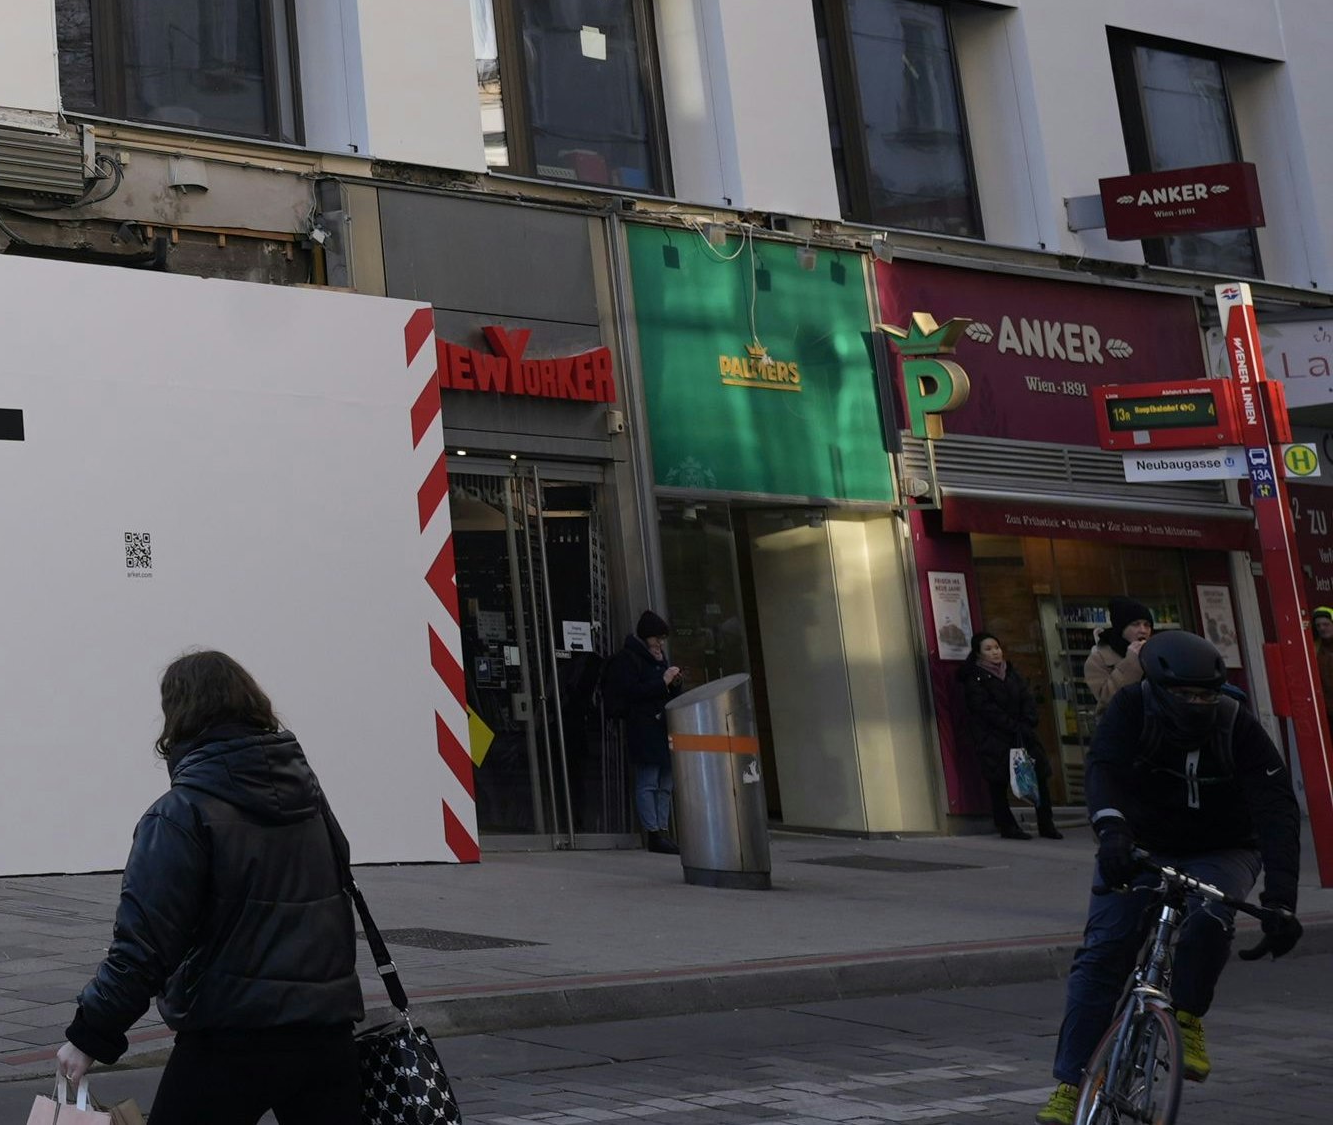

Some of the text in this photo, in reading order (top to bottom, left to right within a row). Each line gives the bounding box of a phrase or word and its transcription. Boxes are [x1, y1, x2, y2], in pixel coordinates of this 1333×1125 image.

[1137, 182, 1209, 207] ANKER
[998, 315, 1104, 364] ANKER
[718, 354, 802, 385] PALMERS
[1233, 337, 1257, 425] WIENER LINIEN
[1025, 376, 1087, 398] Wien 1891
[1136, 458, 1221, 471] Neubaugasse
[1252, 470, 1272, 481] 13A
